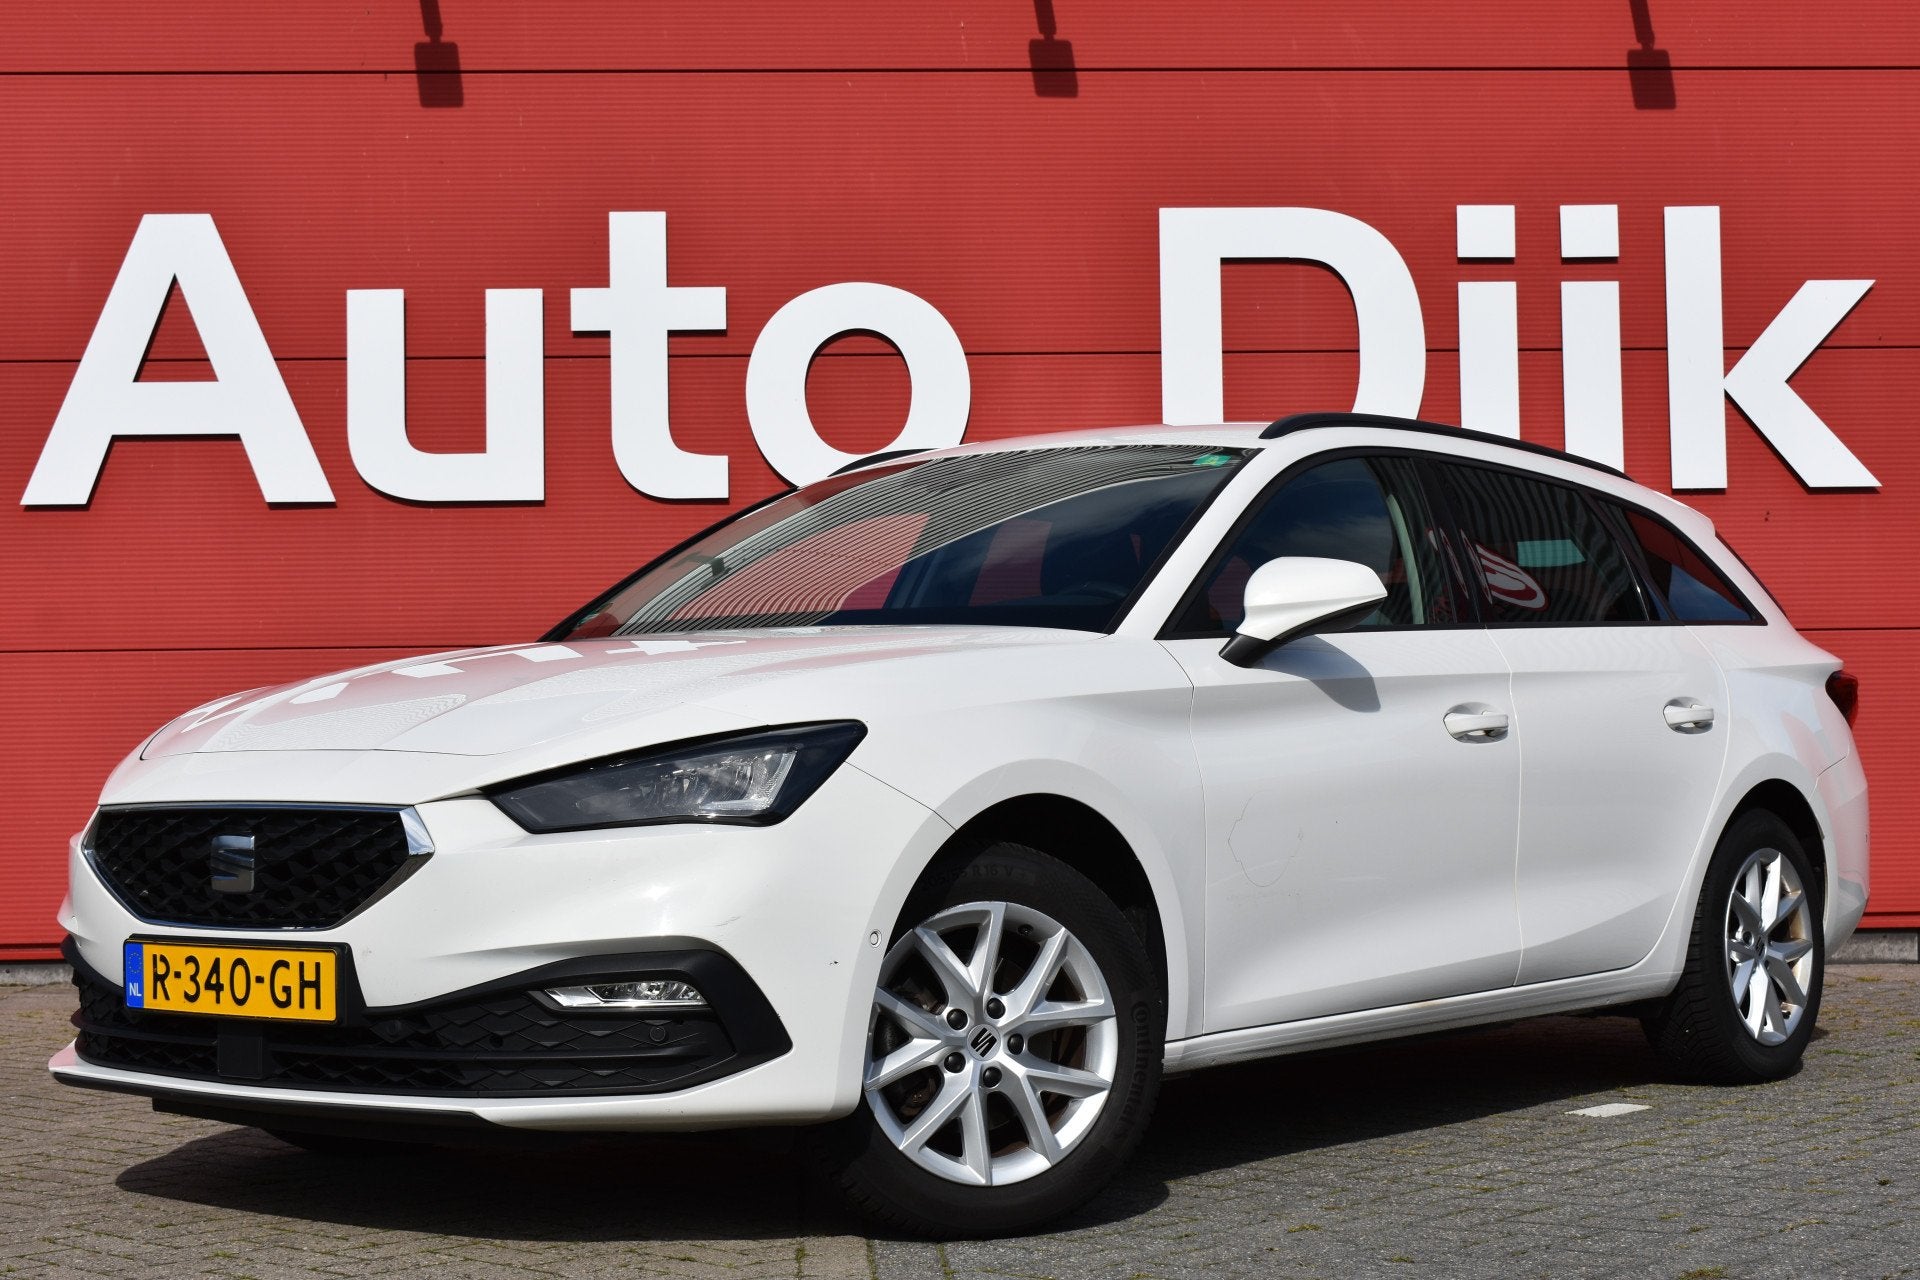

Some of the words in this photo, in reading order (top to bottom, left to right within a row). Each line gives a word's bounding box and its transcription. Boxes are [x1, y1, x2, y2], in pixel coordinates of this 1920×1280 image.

[20, 211, 971, 504] Auto
[1158, 204, 1881, 490] Dijk
[129, 982, 142, 997] NL
[152, 953, 321, 1010] R-340-GH
